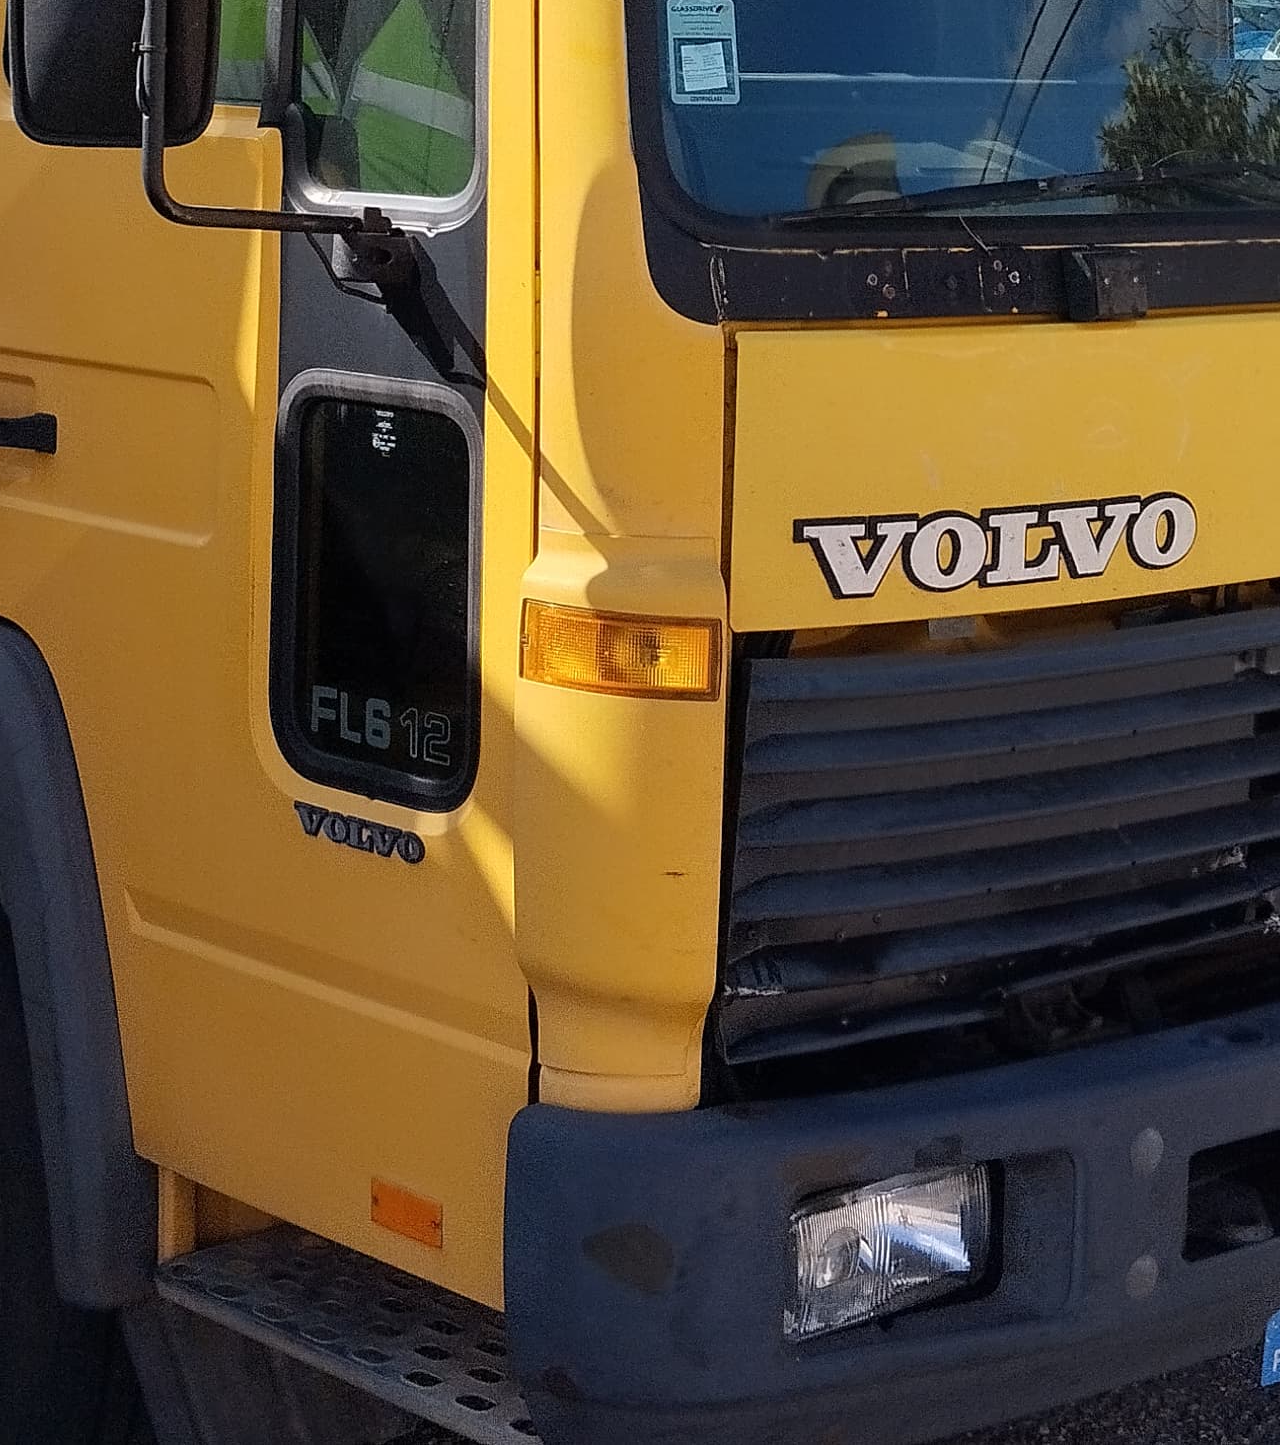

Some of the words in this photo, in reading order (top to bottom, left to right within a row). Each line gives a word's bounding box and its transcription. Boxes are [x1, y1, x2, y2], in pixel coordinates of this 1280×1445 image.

[793, 491, 1198, 599] VOLVO
[310, 684, 392, 750] FL6
[399, 707, 452, 767] 12
[294, 800, 426, 865] VOLVO
